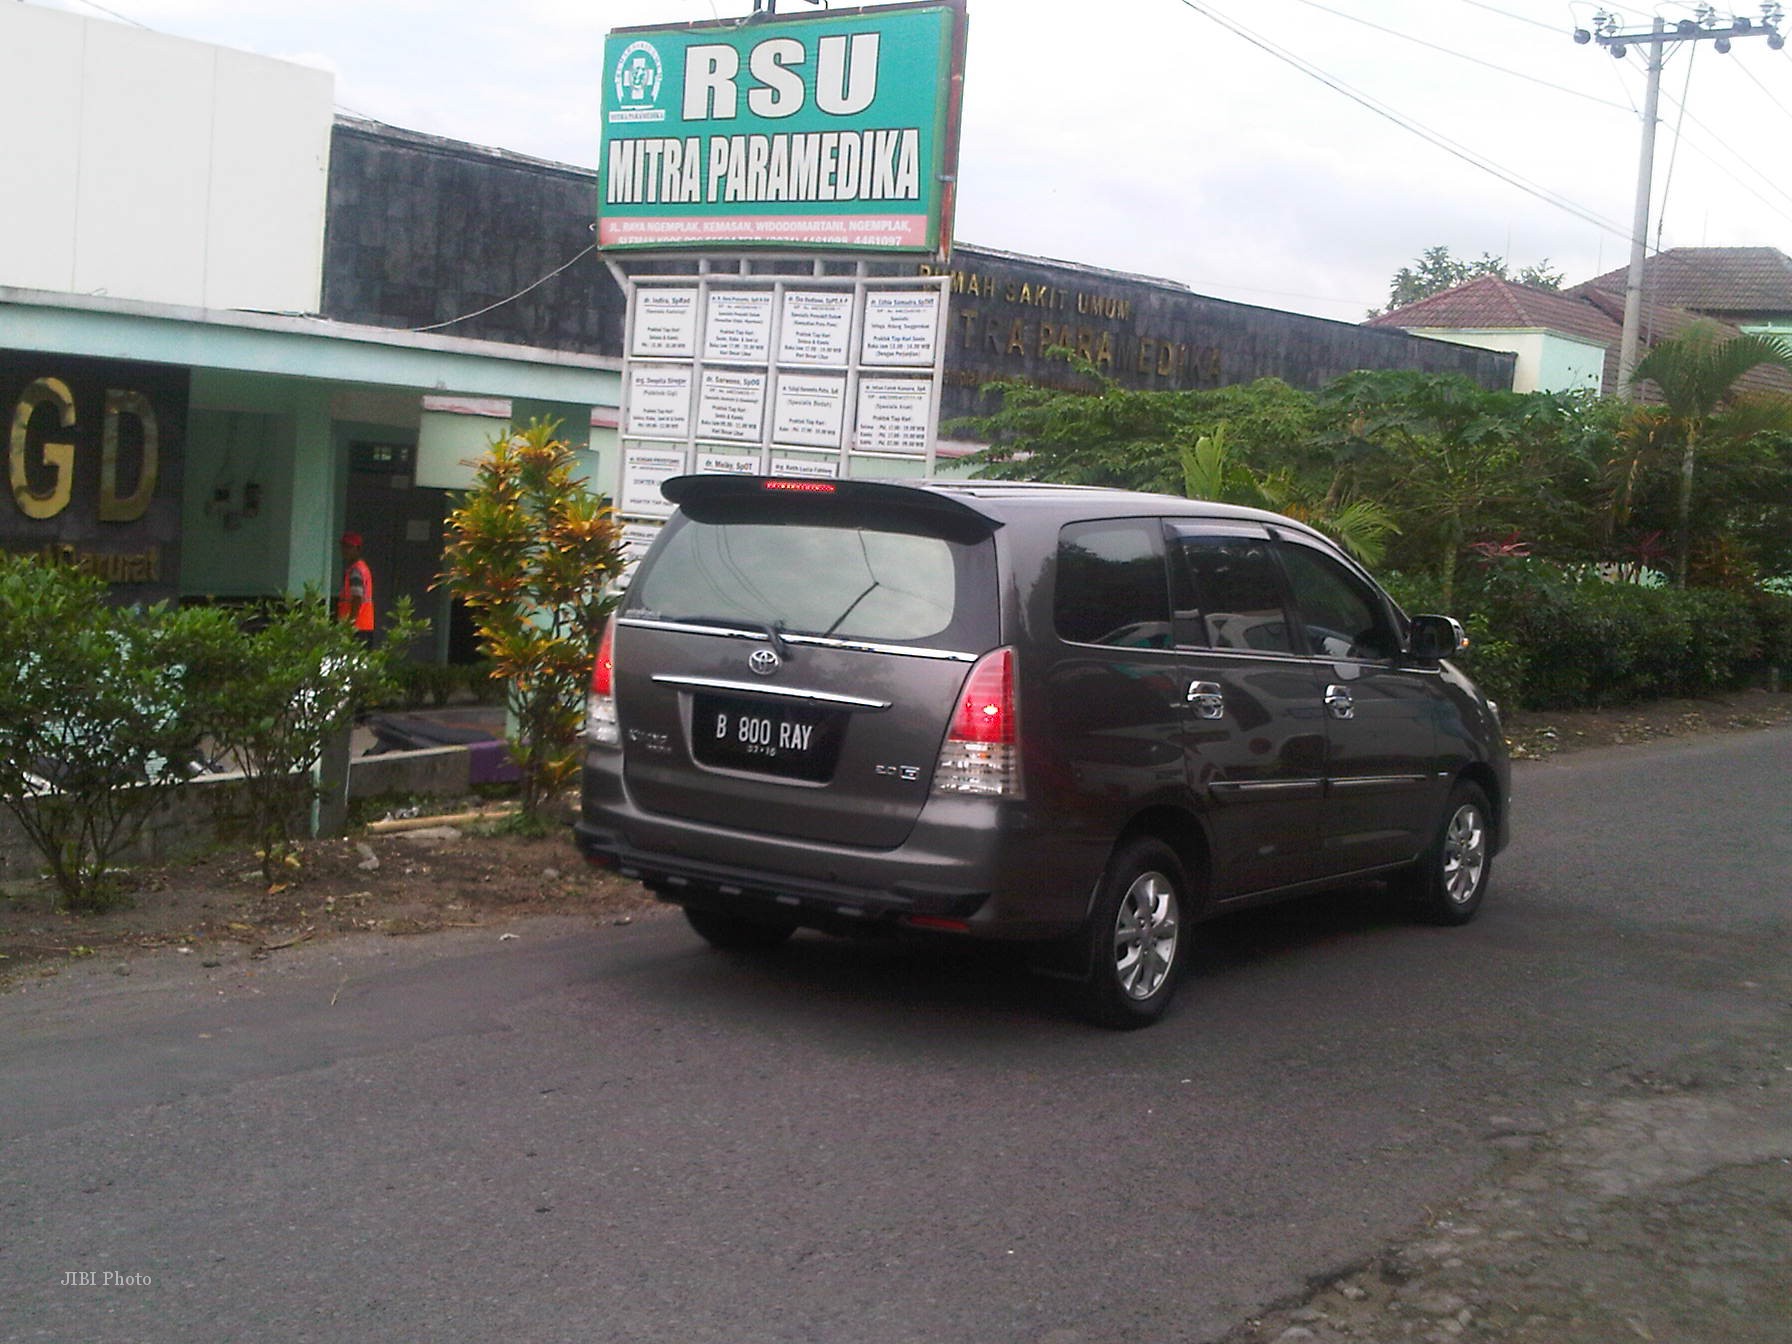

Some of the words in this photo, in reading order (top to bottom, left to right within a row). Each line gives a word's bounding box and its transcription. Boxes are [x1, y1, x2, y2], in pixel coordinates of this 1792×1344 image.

[682, 32, 880, 121] RSU
[606, 136, 701, 205] MITRA
[707, 128, 919, 202] PARAMEDIKA
[756, 221, 846, 232] WIDODOMARTANI,
[849, 220, 911, 233] NGEMPLAK,
[1005, 276, 1068, 310] SAKIT
[1077, 292, 1131, 321] UMUM
[716, 713, 727, 739] B
[738, 716, 771, 745] 800
[779, 722, 813, 751] RAY
